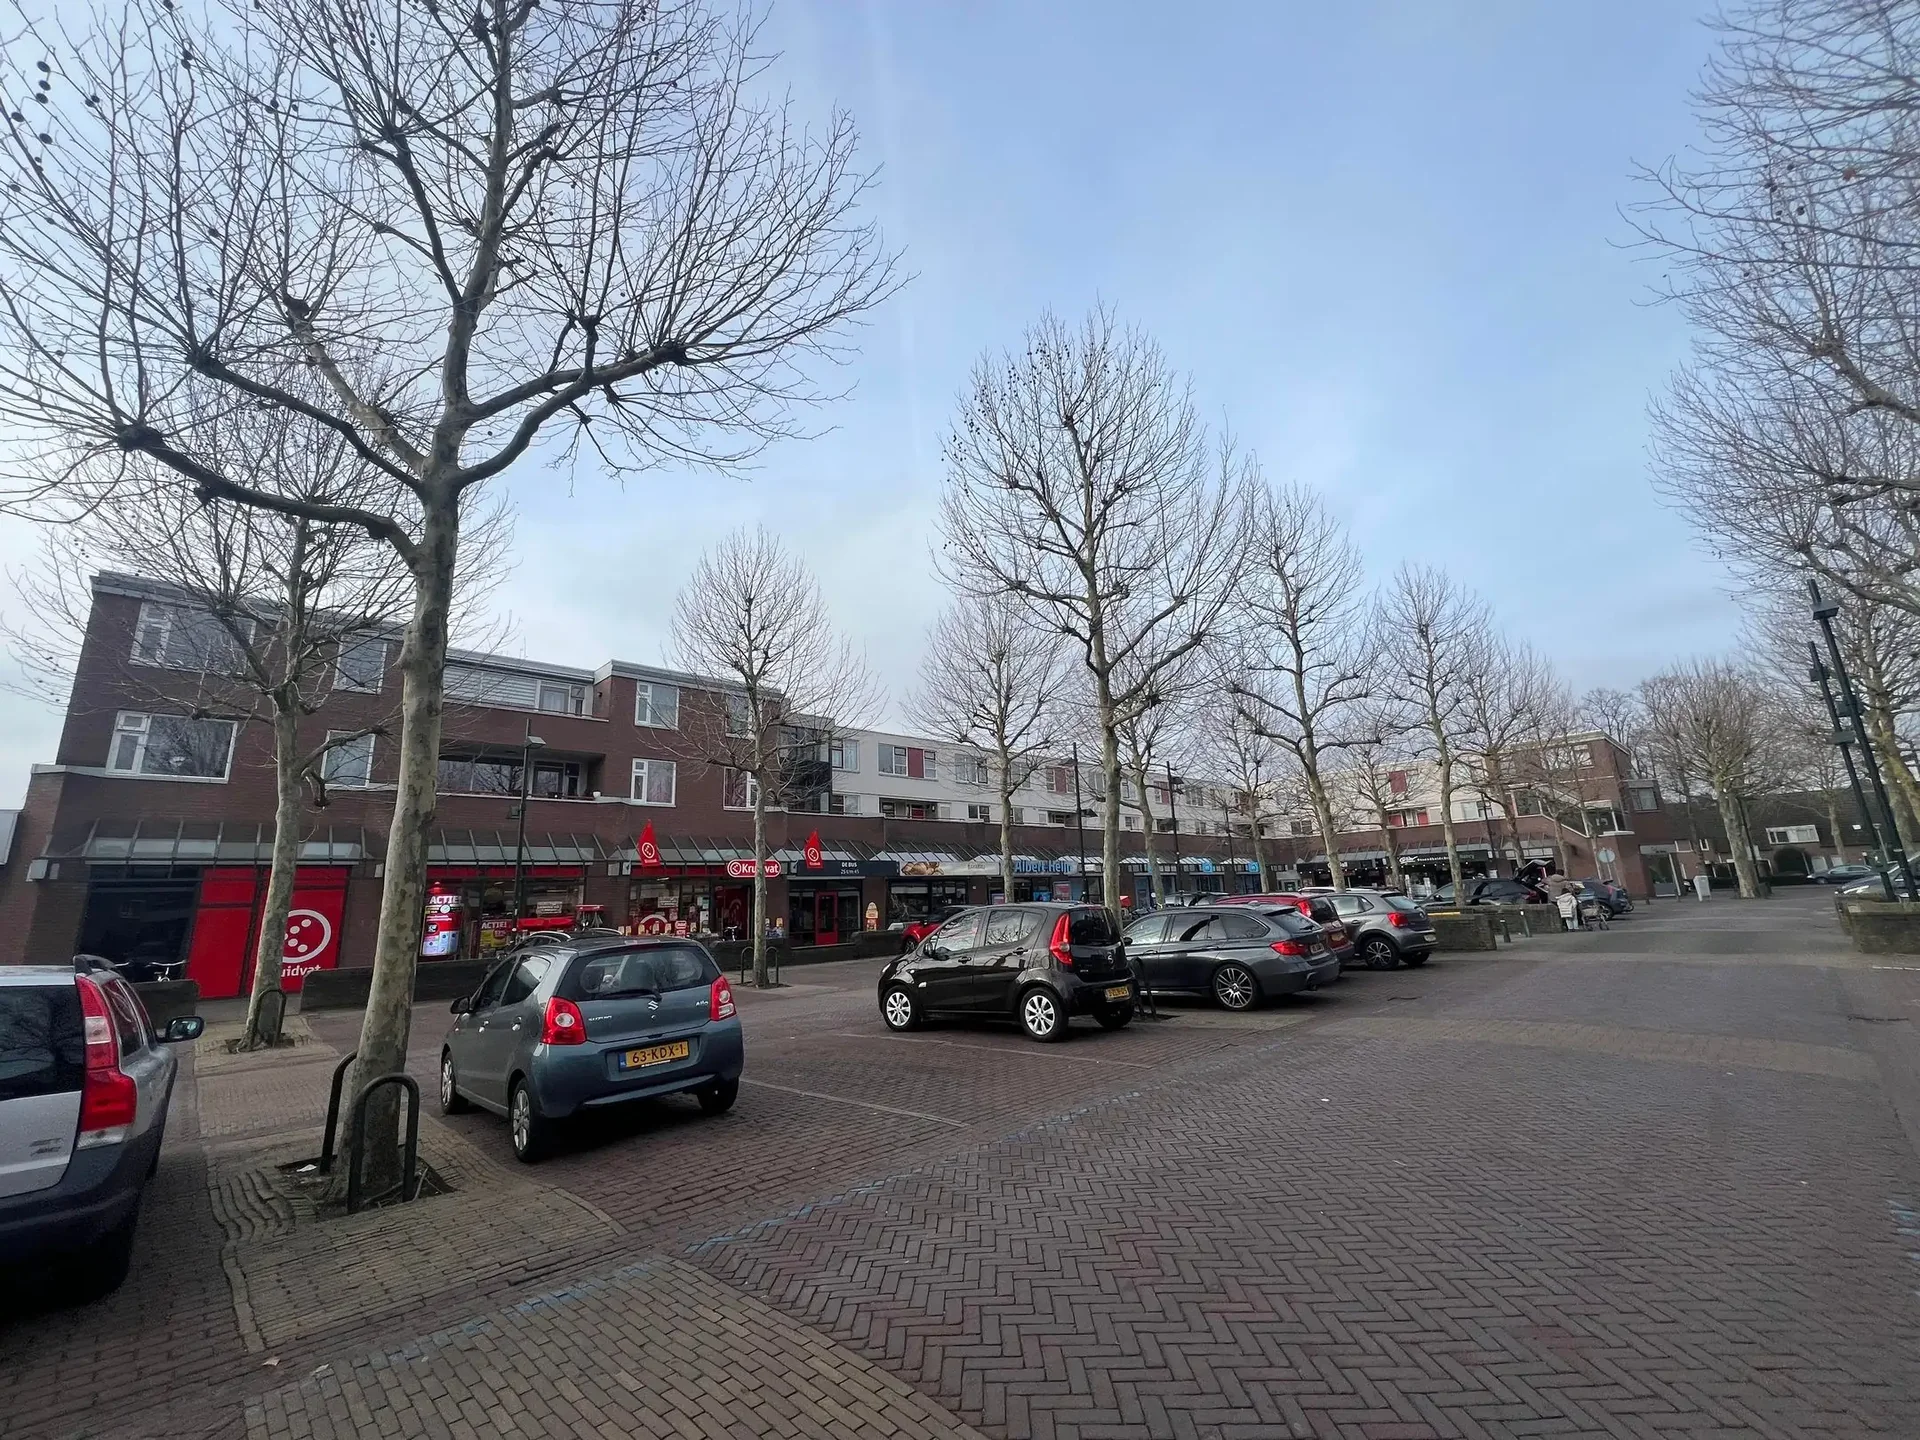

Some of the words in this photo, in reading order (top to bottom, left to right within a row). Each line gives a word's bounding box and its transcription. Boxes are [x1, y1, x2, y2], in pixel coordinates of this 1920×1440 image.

[742, 863, 779, 873] Kruvat
[1015, 860, 1046, 873] Albert
[1048, 860, 1073, 874] Heijn
[632, 1043, 684, 1064] 63-KDX-1
